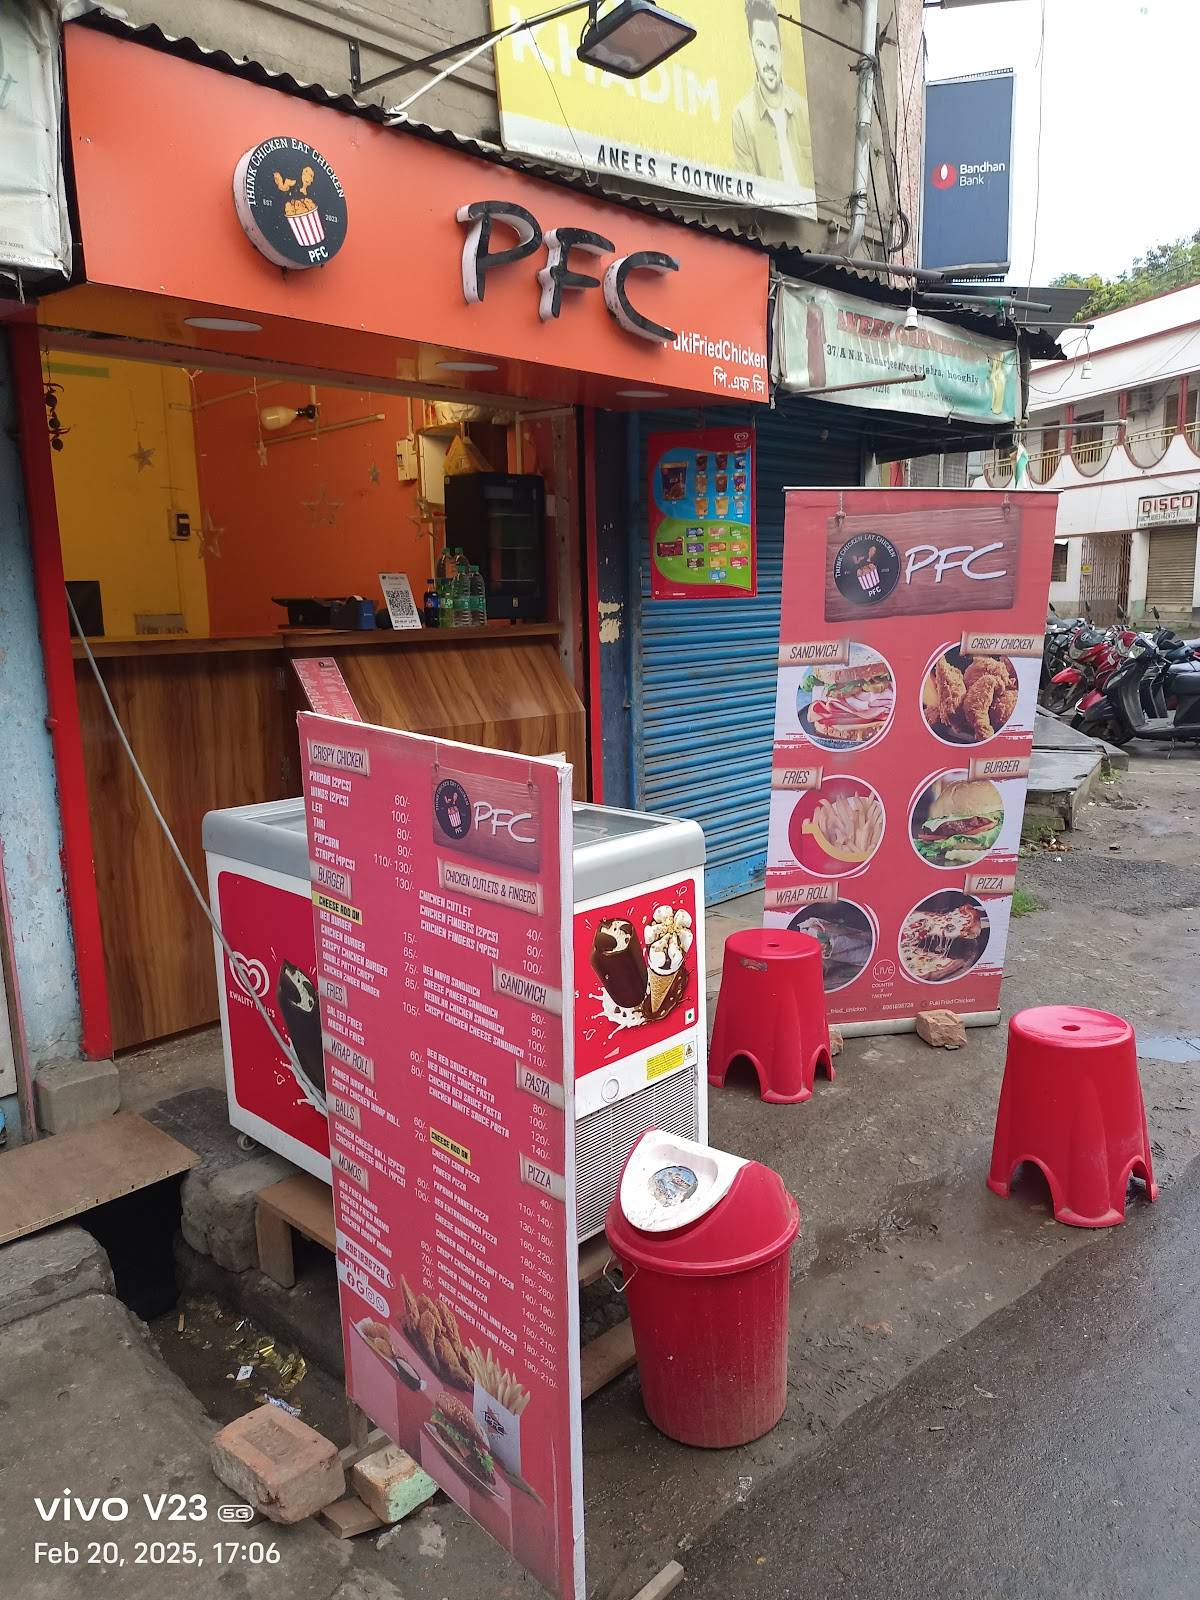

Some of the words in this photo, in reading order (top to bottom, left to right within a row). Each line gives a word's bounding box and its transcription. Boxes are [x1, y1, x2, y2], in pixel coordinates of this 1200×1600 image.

[251, 138, 288, 167] CHICKEN
[291, 138, 310, 154] EAT
[312, 149, 345, 198] CHICKEN
[597, 144, 657, 178] ANEES
[671, 162, 755, 199] FOOTWEAR
[960, 162, 1005, 174] Bandhan
[246, 166, 257, 208] THINK
[960, 175, 984, 187] Bank
[308, 246, 328, 262] PFC
[455, 200, 681, 344] PFC
[1142, 495, 1193, 513] DISCO
[905, 542, 1007, 585] PFC
[868, 587, 882, 598] PFC
[790, 644, 839, 661] SANDWICH
[971, 638, 999, 650] CRISPY
[1001, 637, 1035, 651] CHICKEN
[312, 744, 334, 762] CRISPY
[336, 749, 363, 768] CHICKEN
[983, 760, 1020, 774] BURGER
[782, 770, 810, 786] FRIES
[394, 794, 410, 807] 60/-
[391, 810, 411, 824] 100/-
[474, 801, 536, 843] PFC
[396, 828, 411, 841] 80/-
[397, 845, 412, 858] 90/-
[374, 853, 392, 868] 110/-
[394, 860, 413, 875] 130/-
[317, 866, 344, 891] BURGER
[395, 876, 414, 891] 130/-
[975, 877, 1004, 891] PIZZA
[445, 869, 470, 887] CHICKEN
[472, 876, 498, 895] CUTLETS
[501, 884, 505, 896] &
[508, 885, 536, 906] FINGERS
[775, 887, 805, 904] WRAP
[807, 885, 829, 901] ROLL
[318, 896, 340, 912] CHEESE
[351, 909, 359, 920] ON
[403, 931, 416, 945] 15/-
[419, 890, 444, 906] CHICKEN
[446, 900, 471, 917] CUTLET
[526, 928, 542, 943] 40/-
[420, 905, 445, 922] CHICKEN
[526, 945, 543, 960] 60/-
[420, 920, 446, 938] CHICKEN
[523, 960, 543, 976] 100/-
[404, 961, 418, 976] 75/-
[326, 981, 343, 1002] FRIES
[404, 976, 419, 991] 85/-
[500, 972, 546, 1005] SANDWICH
[229, 989, 254, 1009] KWALITY
[402, 1000, 420, 1017] 105/-
[531, 1012, 545, 1026] 80/-
[531, 1026, 546, 1040] 90/-
[527, 1039, 546, 1054] 100/-
[331, 1038, 350, 1062] WRAP
[352, 1051, 368, 1074] ROLL
[528, 1053, 546, 1069] 110/-
[524, 1072, 549, 1098] PASTA
[335, 1097, 354, 1122] BALLS
[532, 1103, 547, 1118] 80/-
[529, 1116, 547, 1132] 100/-
[531, 1130, 549, 1147] 120/-
[532, 1144, 550, 1161] 140/-
[338, 1152, 361, 1181] MOMOS
[528, 1164, 550, 1190] PIZZA
